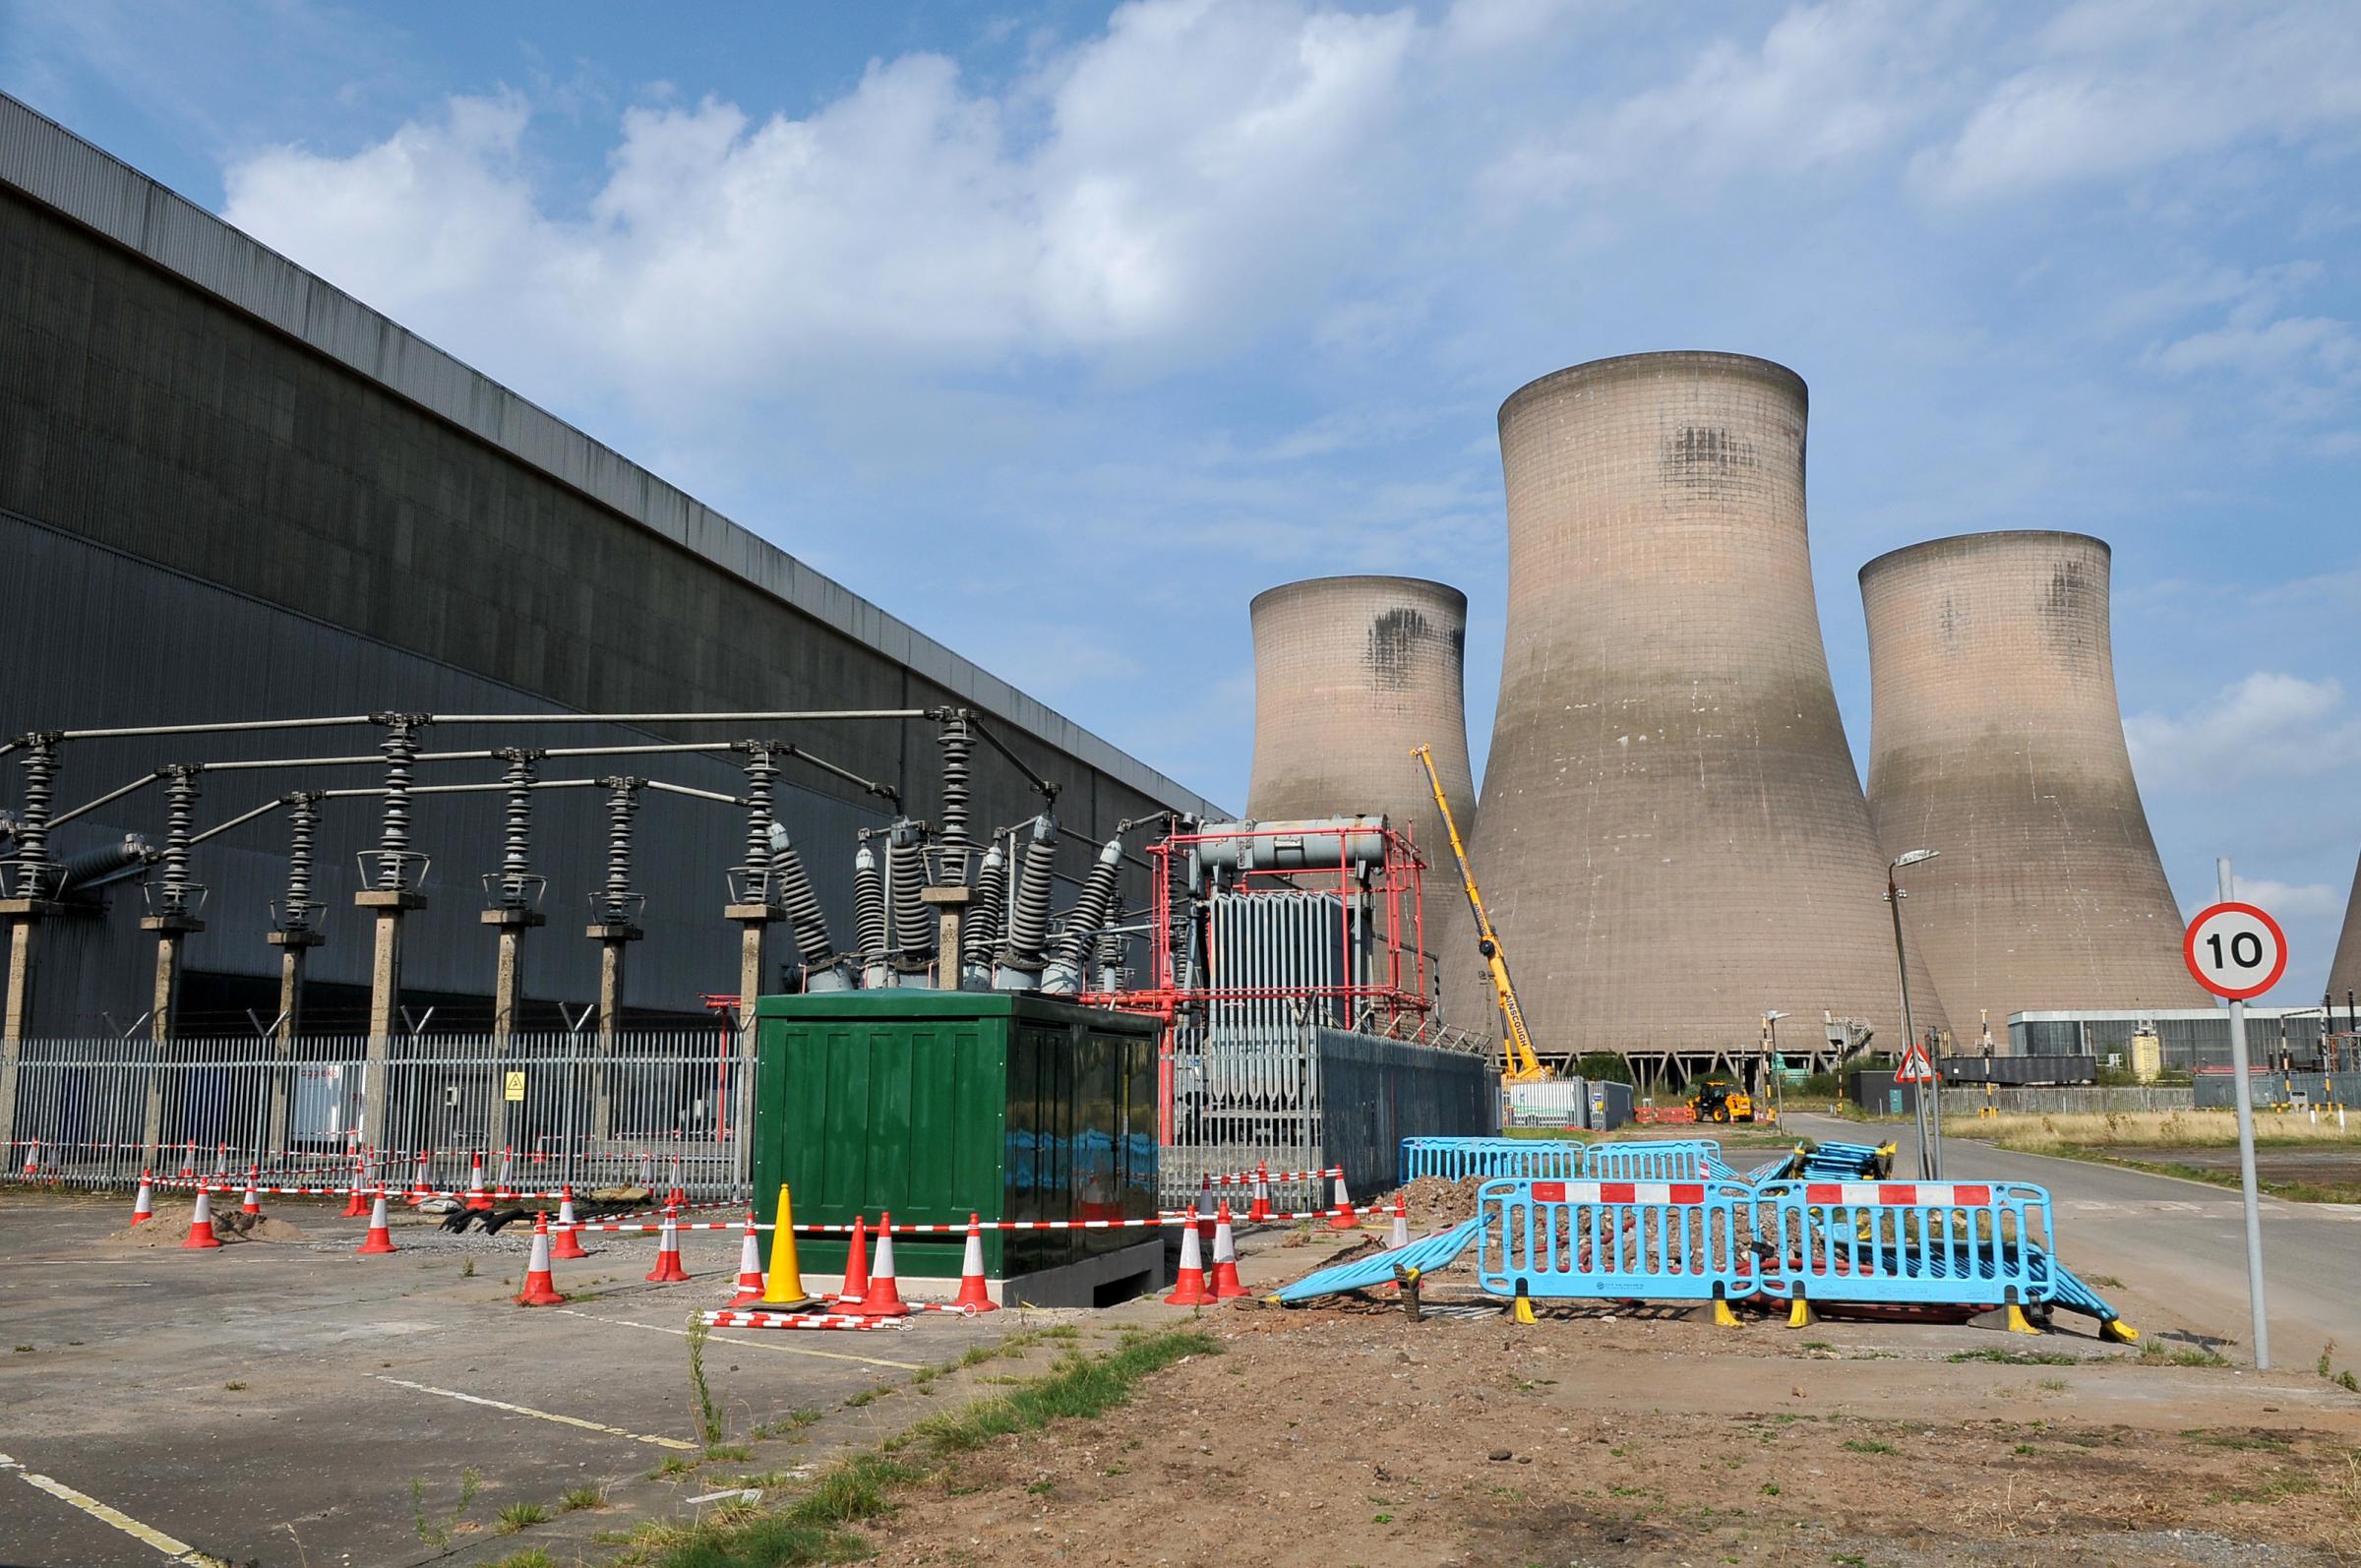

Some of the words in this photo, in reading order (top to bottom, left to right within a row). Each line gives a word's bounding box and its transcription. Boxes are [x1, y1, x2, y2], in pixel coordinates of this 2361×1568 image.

[2207, 932, 2263, 969] 10
[1505, 995, 1527, 1047] AINSCOUGH
[300, 1067, 338, 1079] aggeko
